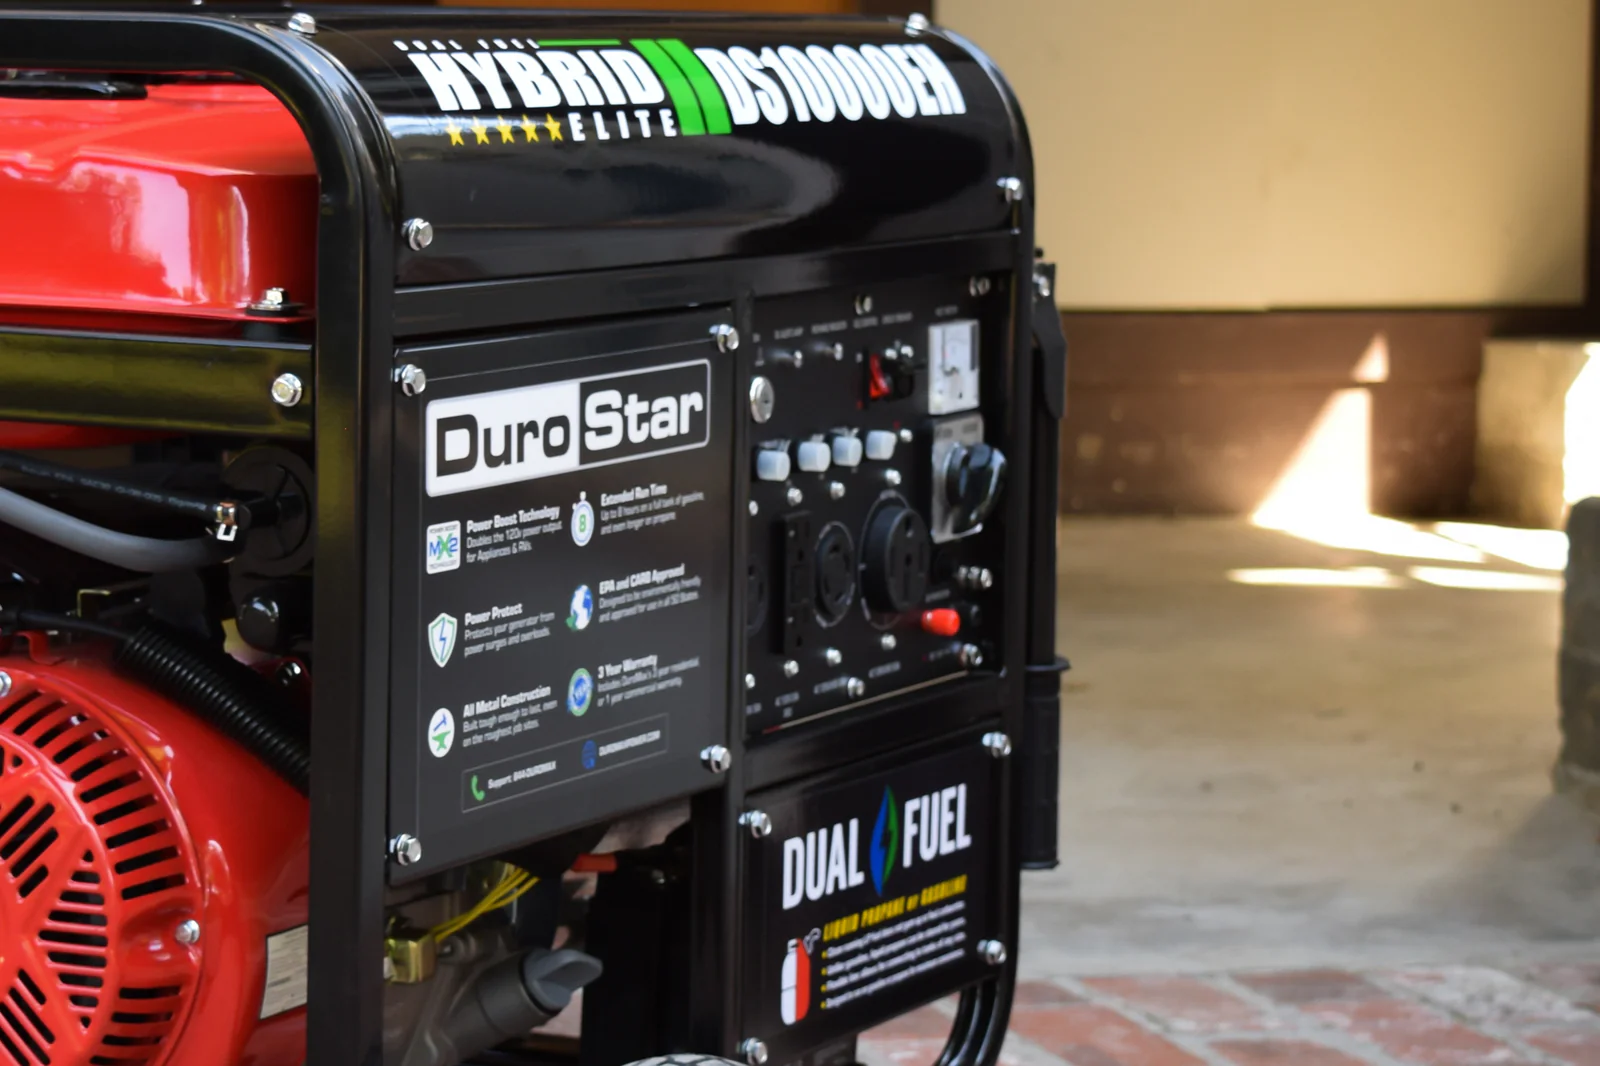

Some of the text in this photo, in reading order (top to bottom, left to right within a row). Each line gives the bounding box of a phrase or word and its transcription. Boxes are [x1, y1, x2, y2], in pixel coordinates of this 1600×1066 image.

[407, 50, 666, 112] HYBRID
[567, 108, 678, 142] ELITE
[635, 486, 650, 500] Run
[650, 483, 668, 497] Time
[467, 505, 560, 534] Power Boost Technology
[579, 514, 586, 532] 8
[467, 536, 492, 549] Doubles
[493, 533, 504, 543] the
[522, 525, 542, 539] power
[466, 552, 477, 563] for
[477, 546, 511, 562] Appliances
[600, 579, 615, 595] EPA
[616, 576, 629, 591] and
[652, 562, 685, 584] Approved
[465, 603, 523, 626] Power Protect
[465, 612, 555, 641] Protects your generator from
[464, 643, 485, 658] power
[485, 638, 507, 652] surges
[508, 632, 520, 645] and
[598, 665, 604, 679] 3
[605, 663, 622, 677] Year
[463, 703, 475, 718] All
[476, 696, 500, 715] Metal
[501, 685, 551, 708] Construction
[478, 715, 497, 728] tough
[521, 707, 528, 717] to
[463, 738, 472, 747] on
[472, 733, 484, 744] the
[484, 725, 512, 742] roughest
[513, 722, 523, 736] job
[782, 782, 972, 910] DUAL FUEL
[822, 913, 860, 942] LIQUID
[860, 896, 906, 928] PROPANE
[920, 874, 968, 906] GASOLINE
